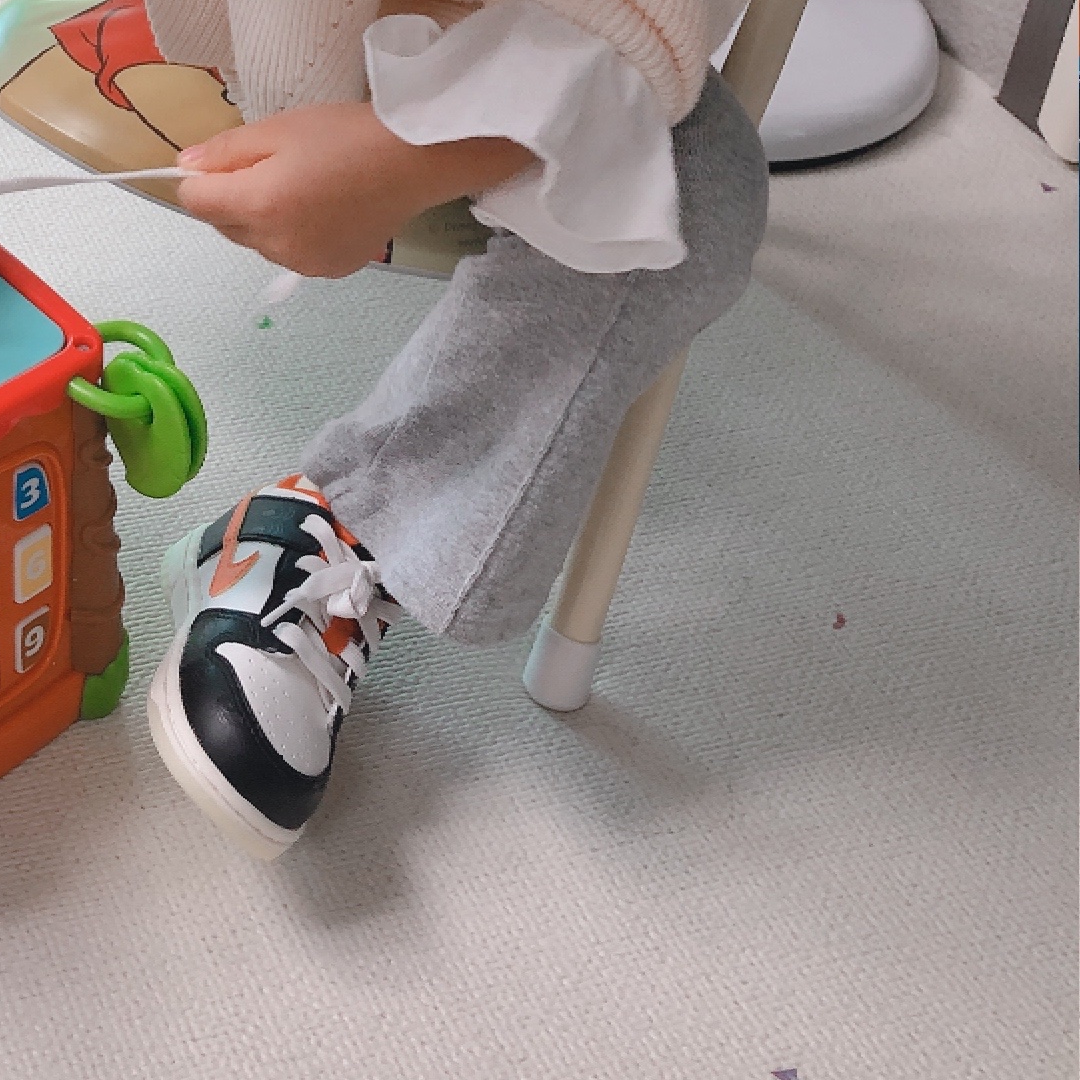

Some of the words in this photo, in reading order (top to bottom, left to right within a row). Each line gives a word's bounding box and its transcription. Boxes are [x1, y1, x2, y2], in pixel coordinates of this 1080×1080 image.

[20, 477, 41, 510] 3
[26, 549, 46, 581] 6
[24, 625, 44, 657] 9
